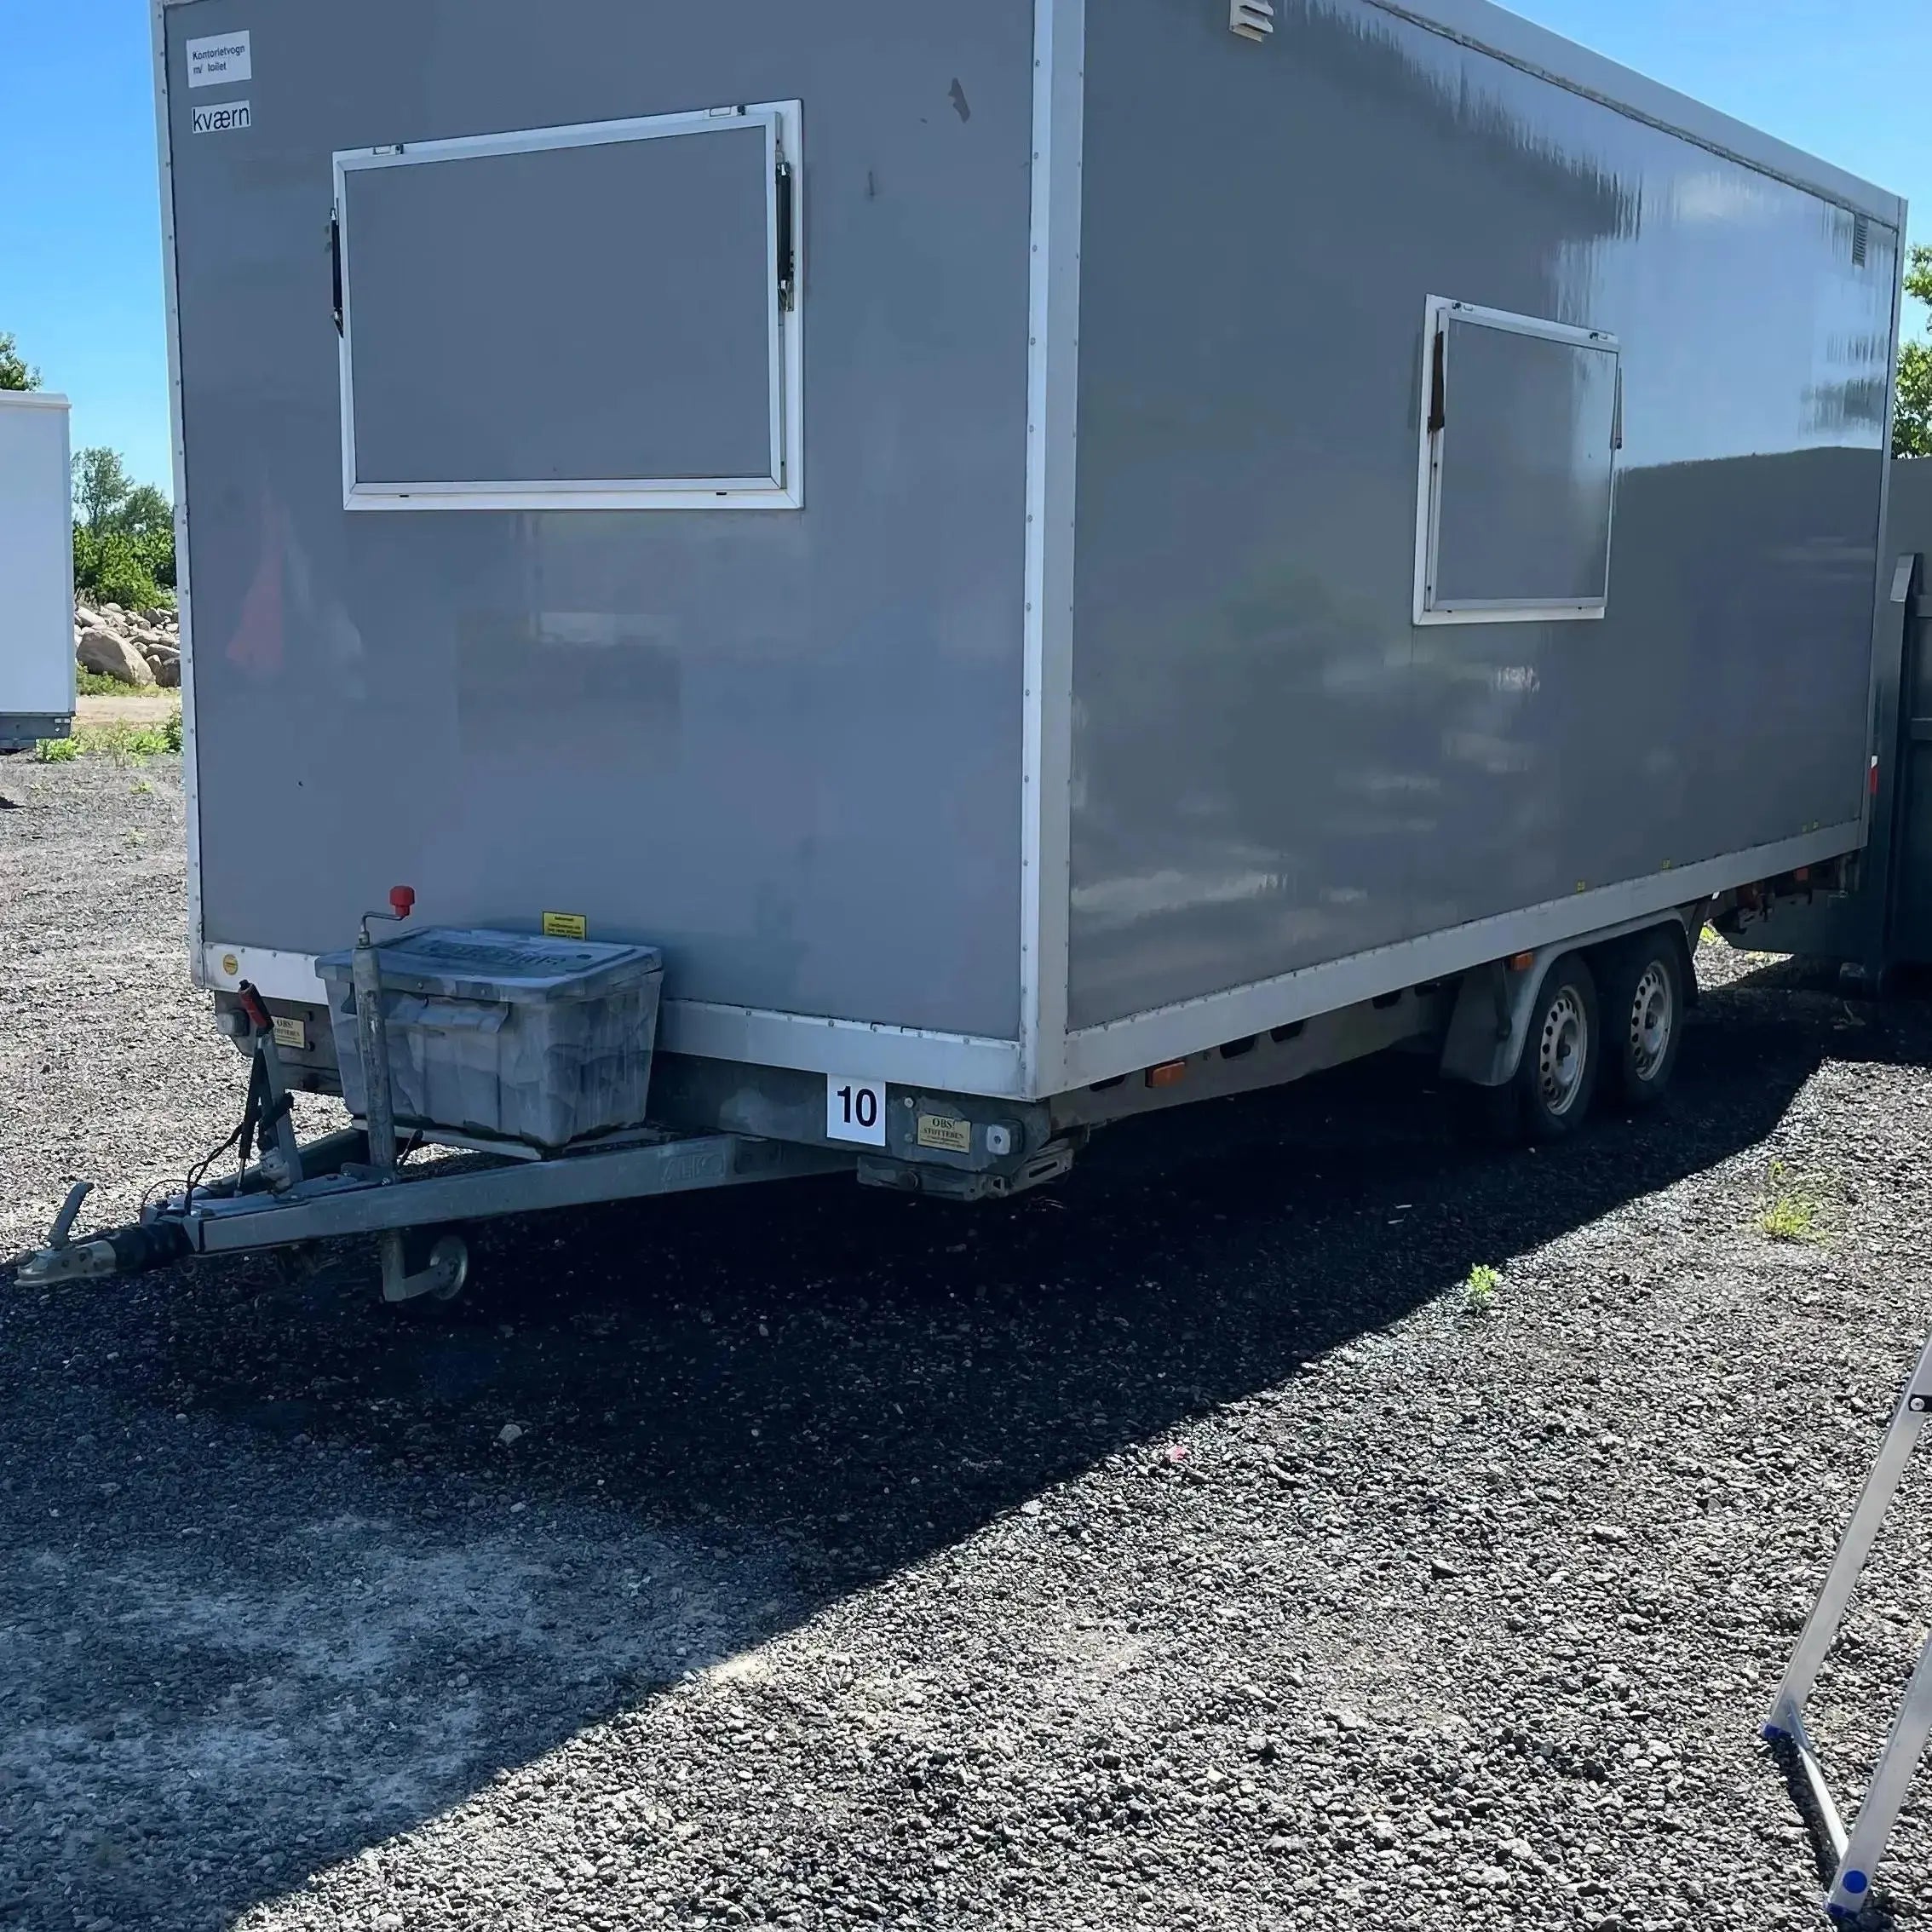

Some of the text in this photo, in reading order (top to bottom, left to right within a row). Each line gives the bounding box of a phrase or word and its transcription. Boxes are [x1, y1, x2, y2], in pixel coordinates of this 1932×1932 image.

[208, 61, 227, 72] toilet
[193, 106, 250, 132] kværn
[837, 1085, 877, 1127] 10
[932, 1118, 955, 1130] OBS!
